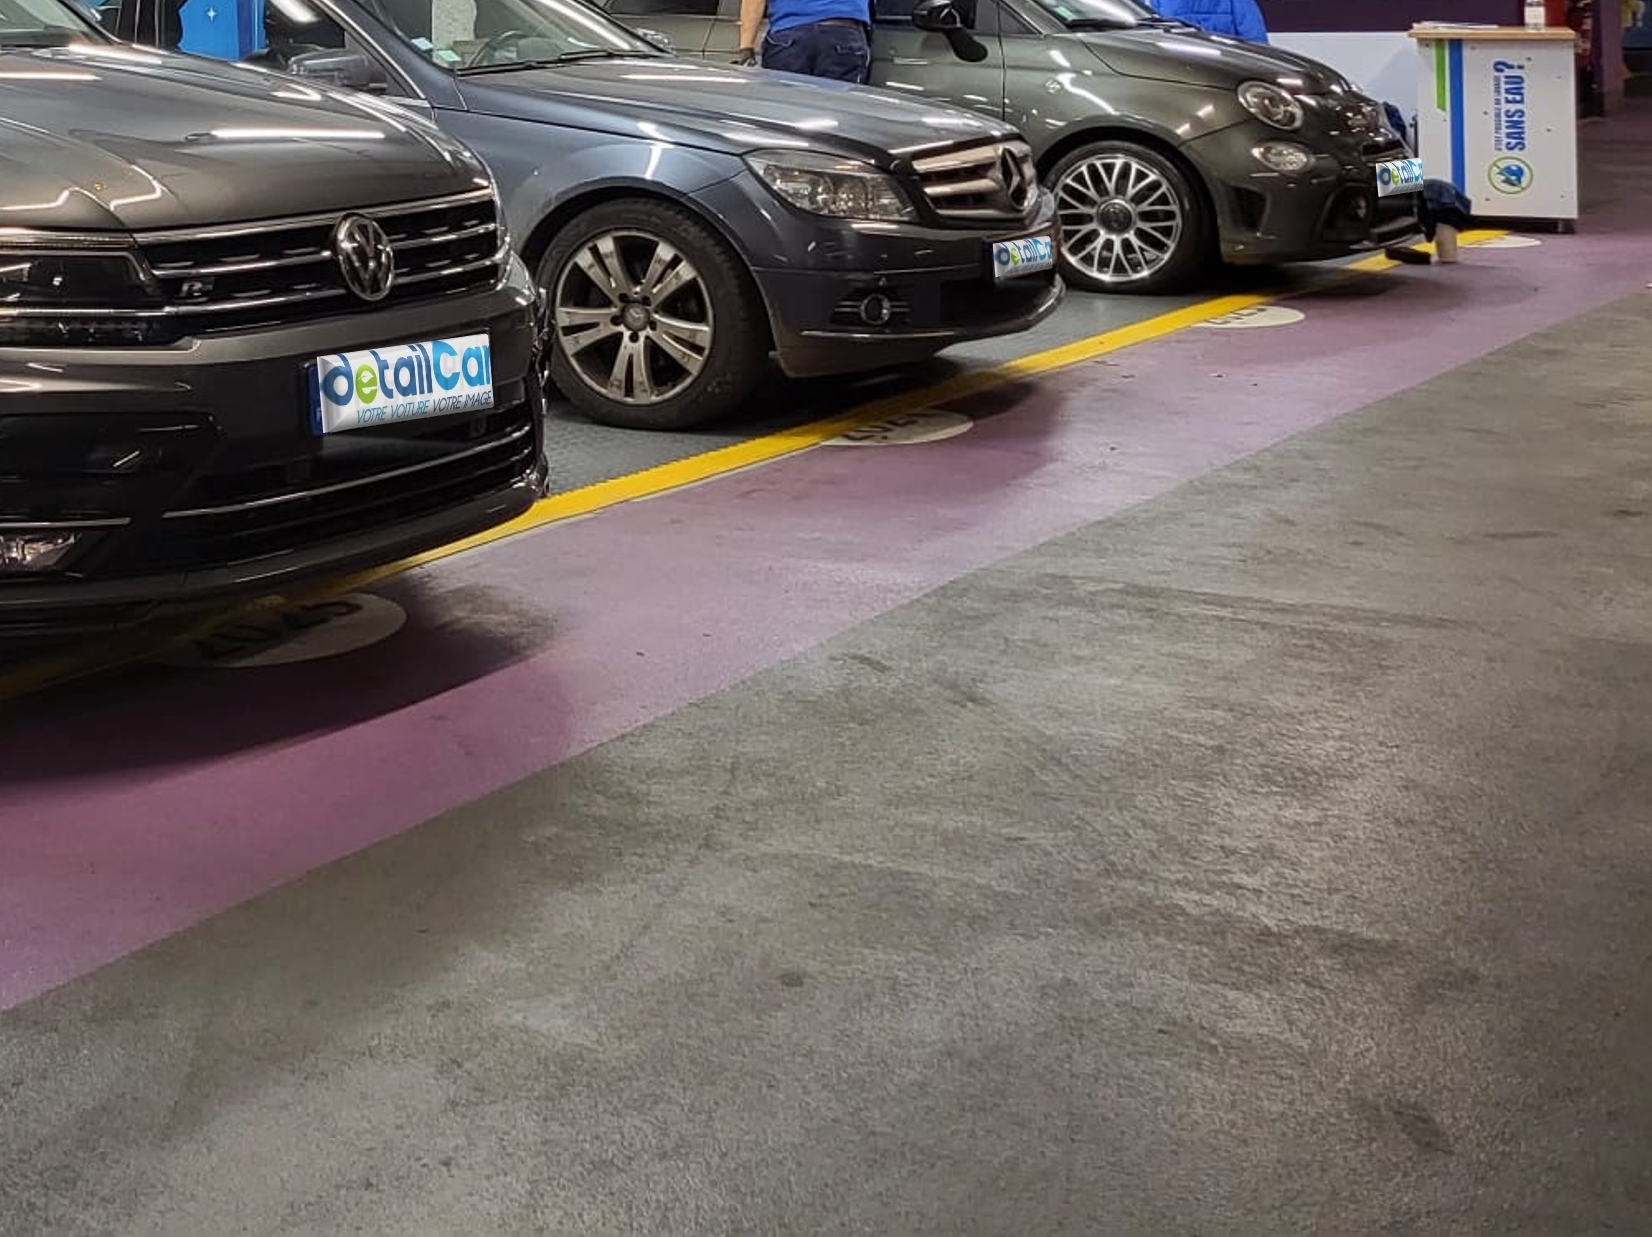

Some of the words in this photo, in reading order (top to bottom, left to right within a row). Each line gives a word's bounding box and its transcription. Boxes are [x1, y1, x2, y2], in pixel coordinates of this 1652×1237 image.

[1505, 109, 1526, 151] SANS
[357, 405, 388, 424] VOTRE
[391, 400, 431, 419] VOITURE
[433, 394, 463, 412] VOTRE
[463, 390, 492, 409] IMAGE
